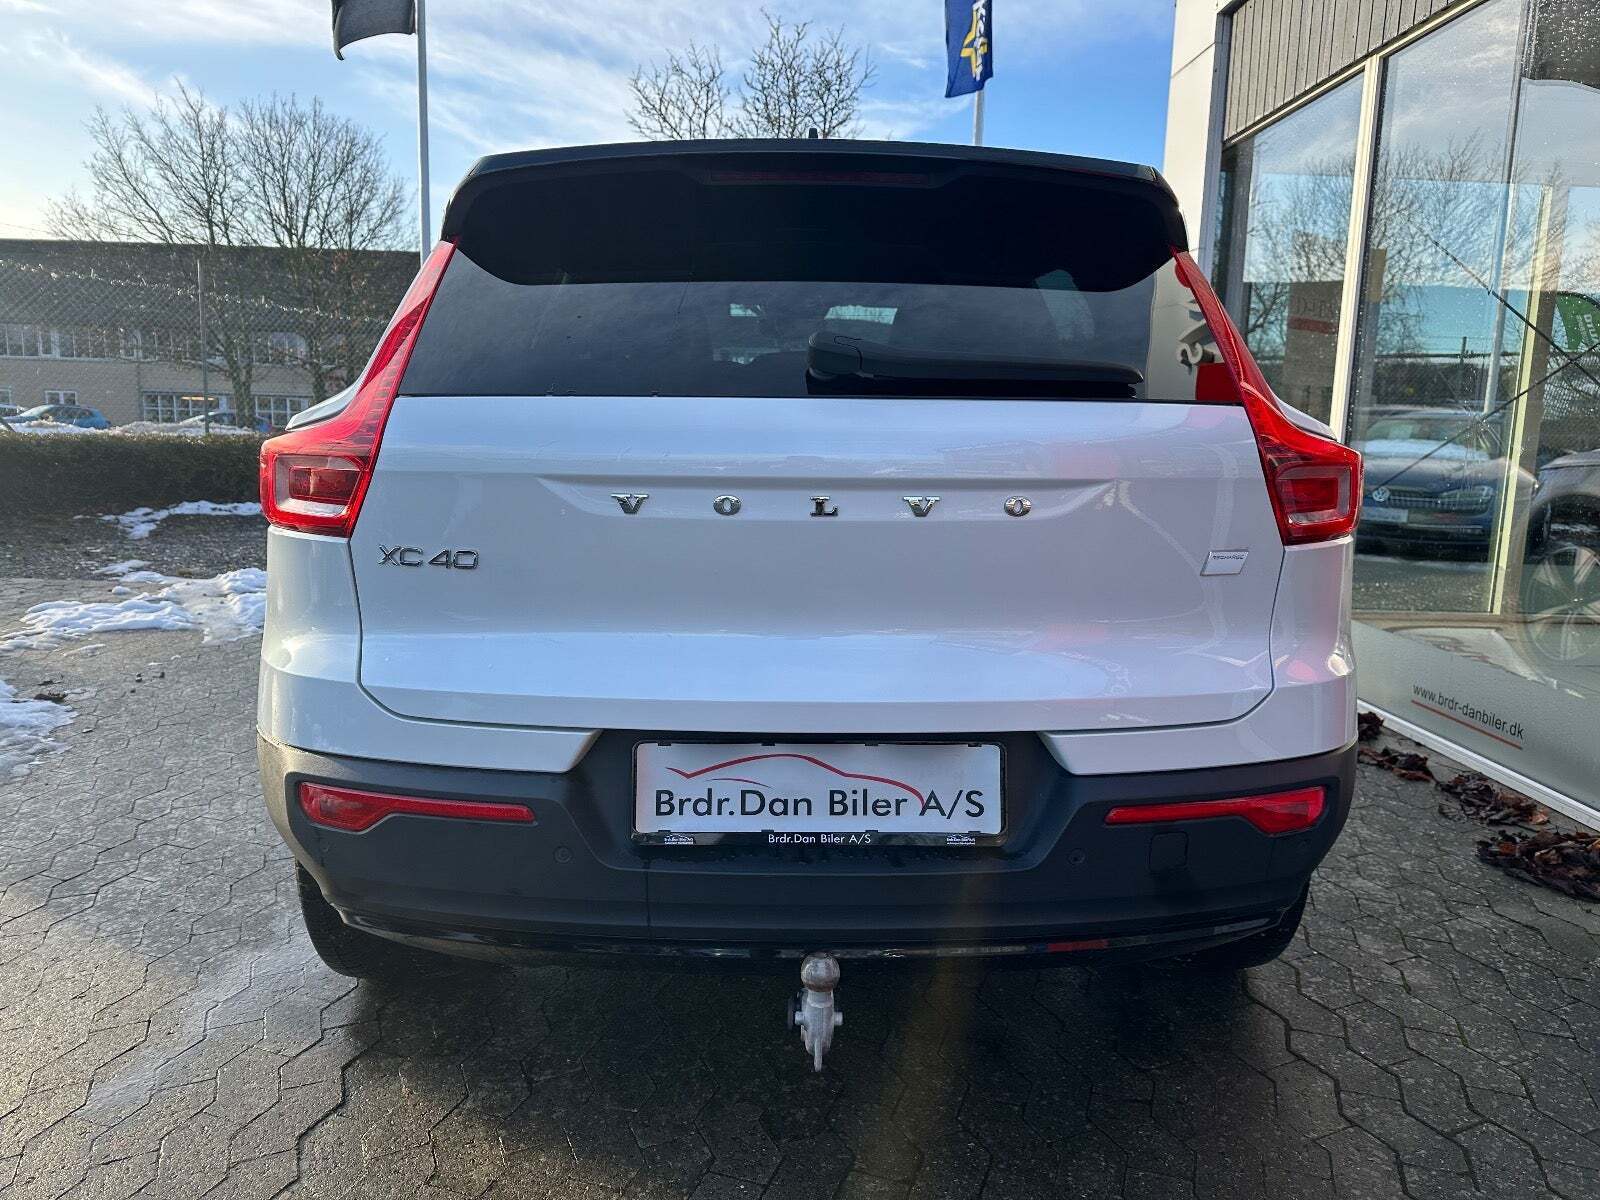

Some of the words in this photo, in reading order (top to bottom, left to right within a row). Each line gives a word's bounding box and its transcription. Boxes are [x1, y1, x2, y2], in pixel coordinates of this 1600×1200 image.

[611, 493, 1032, 518] VOLVO
[1412, 684, 1524, 739] www.brdr-danbiler.dk
[655, 788, 812, 817] Brdr.Dan
[829, 789, 907, 816] Biler
[919, 789, 985, 819] A/S
[768, 833, 816, 844] Brdr.Dan
[820, 833, 845, 844] Biler
[848, 833, 871, 845] A/S
